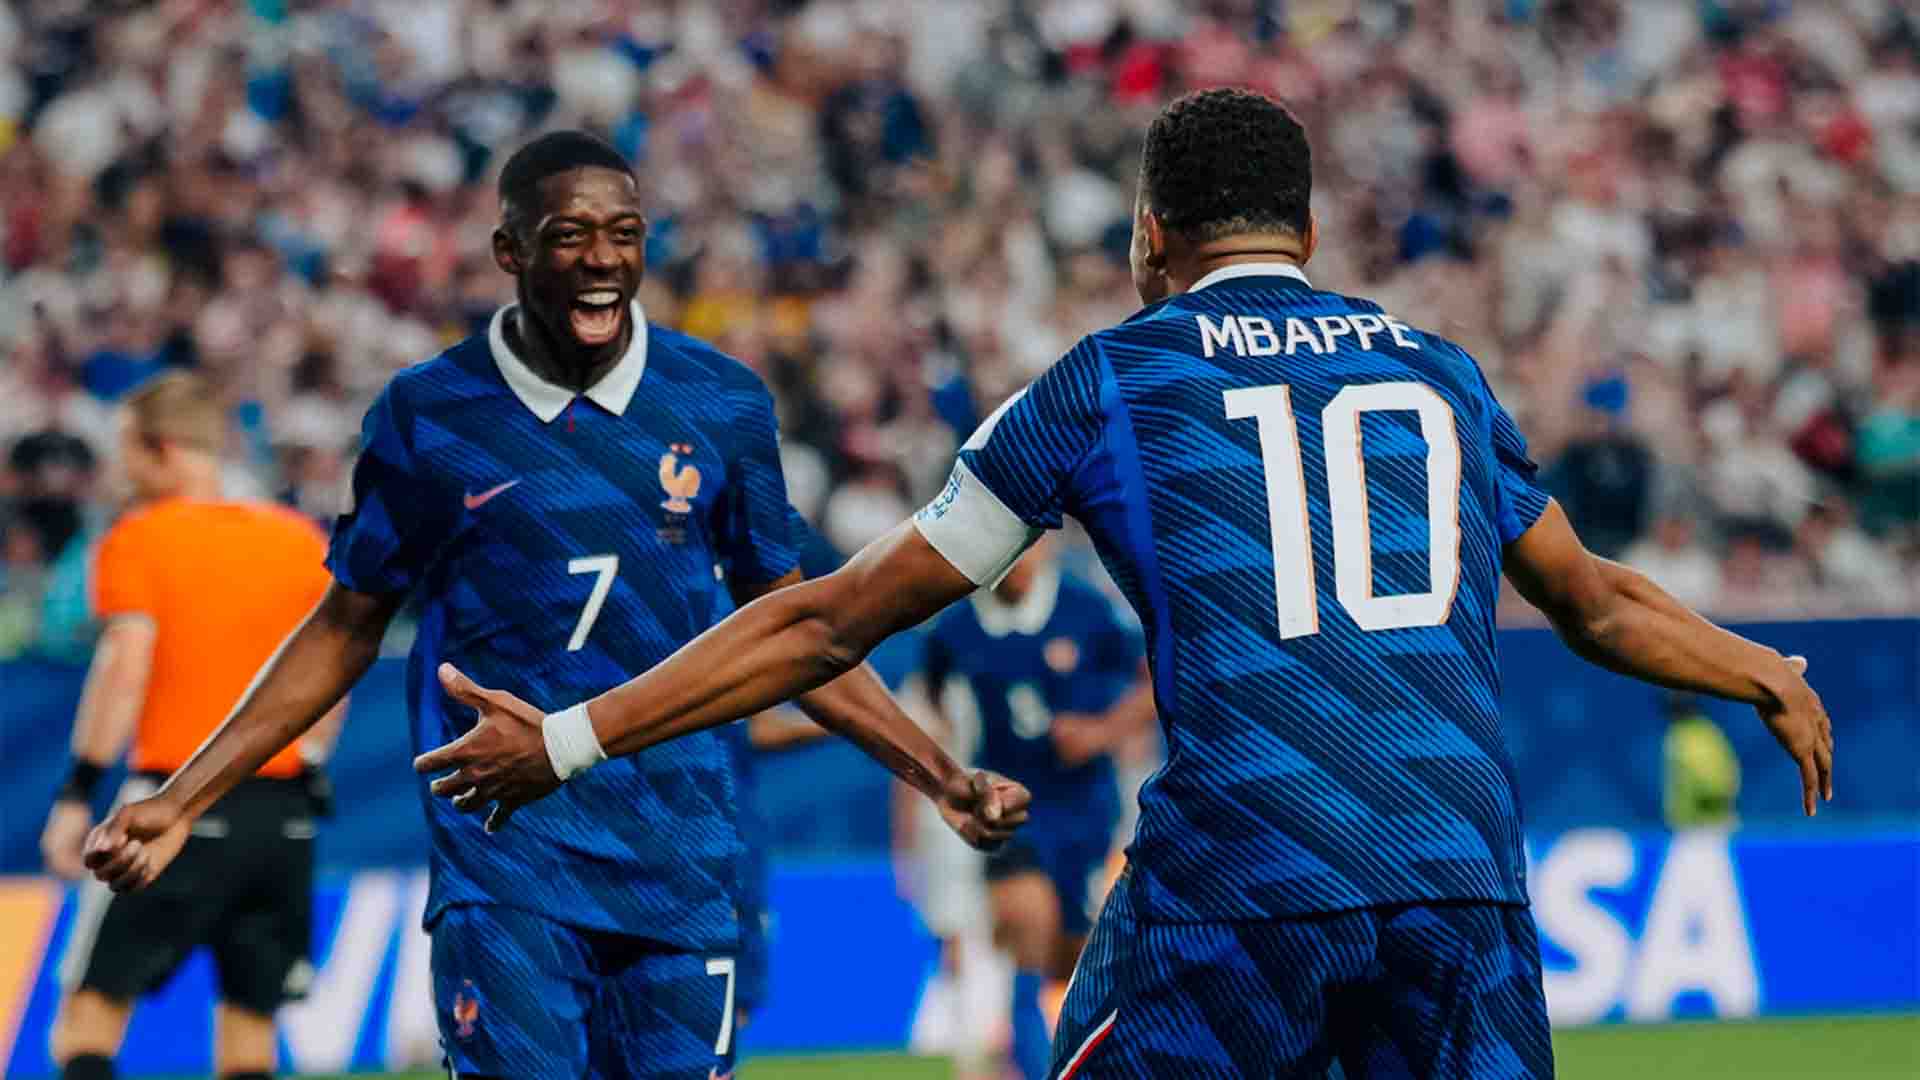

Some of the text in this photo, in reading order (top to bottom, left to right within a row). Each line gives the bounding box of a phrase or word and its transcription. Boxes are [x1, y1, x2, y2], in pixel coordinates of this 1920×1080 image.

[1195, 313, 1419, 358] MBAPPE
[1223, 382, 1461, 640] 10
[567, 555, 619, 652] 7
[1530, 827, 1762, 1027] SA
[705, 959, 735, 1055] 7
